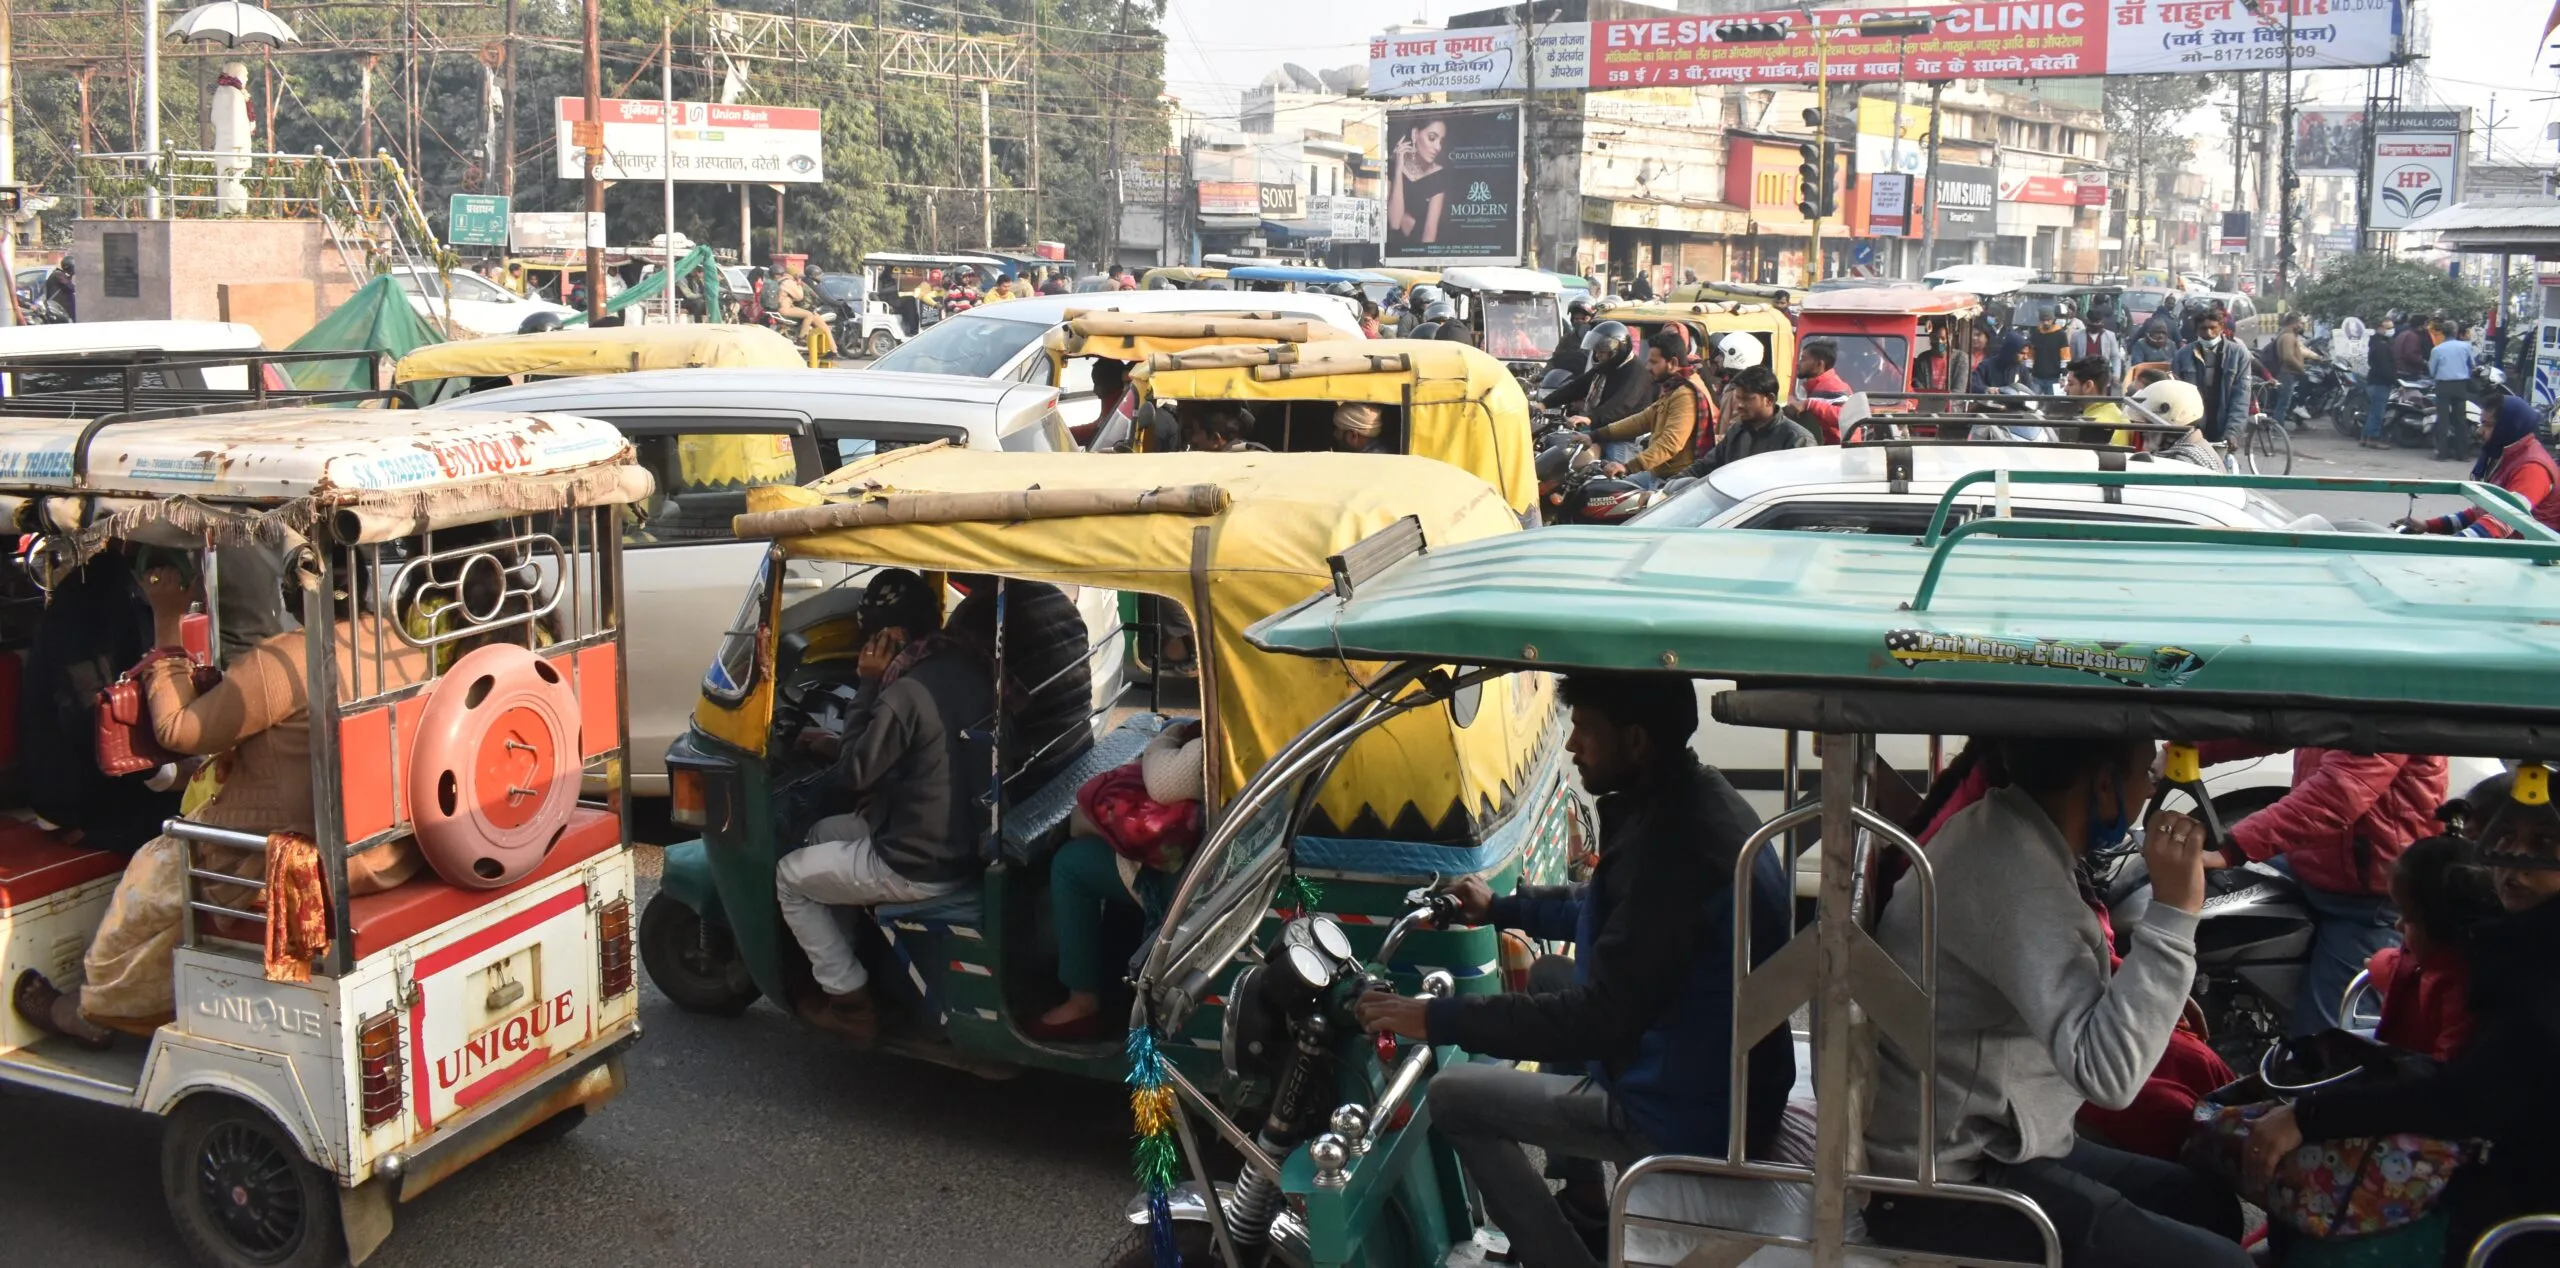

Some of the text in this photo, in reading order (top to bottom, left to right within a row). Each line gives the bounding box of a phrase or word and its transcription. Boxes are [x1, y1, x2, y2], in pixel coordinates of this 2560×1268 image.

[1946, 2, 2085, 34] CLINIC
[2115, 0, 2146, 26] डॉ
[2159, 1, 2233, 30] राहुल
[1370, 35, 1495, 59] डॉ सपन कुमार
[2210, 28, 2245, 45] रोग
[1608, 70, 1629, 82] 59
[1634, 68, 1647, 83] ई
[1669, 68, 1679, 80] 3
[1915, 57, 1943, 74] गेट
[1946, 57, 1967, 73] के
[711, 107, 769, 123] Union Bank
[2431, 118, 2458, 128] SONS
[2398, 171, 2432, 188] HP
[1261, 187, 1295, 209] SONY
[1937, 180, 1993, 206] SAMSUNG
[1450, 203, 1509, 216] MODERN
[378, 452, 436, 483] TRADERS
[435, 437, 533, 479] UNIQUE
[1589, 495, 1616, 503] HERO
[1919, 631, 1959, 651] Pari
[1963, 636, 2018, 659] Metro
[2033, 643, 2048, 662] E
[2052, 646, 2148, 673] Rickshaw
[200, 990, 323, 1040] UNIQUE
[435, 989, 576, 1089] UNIQUE
